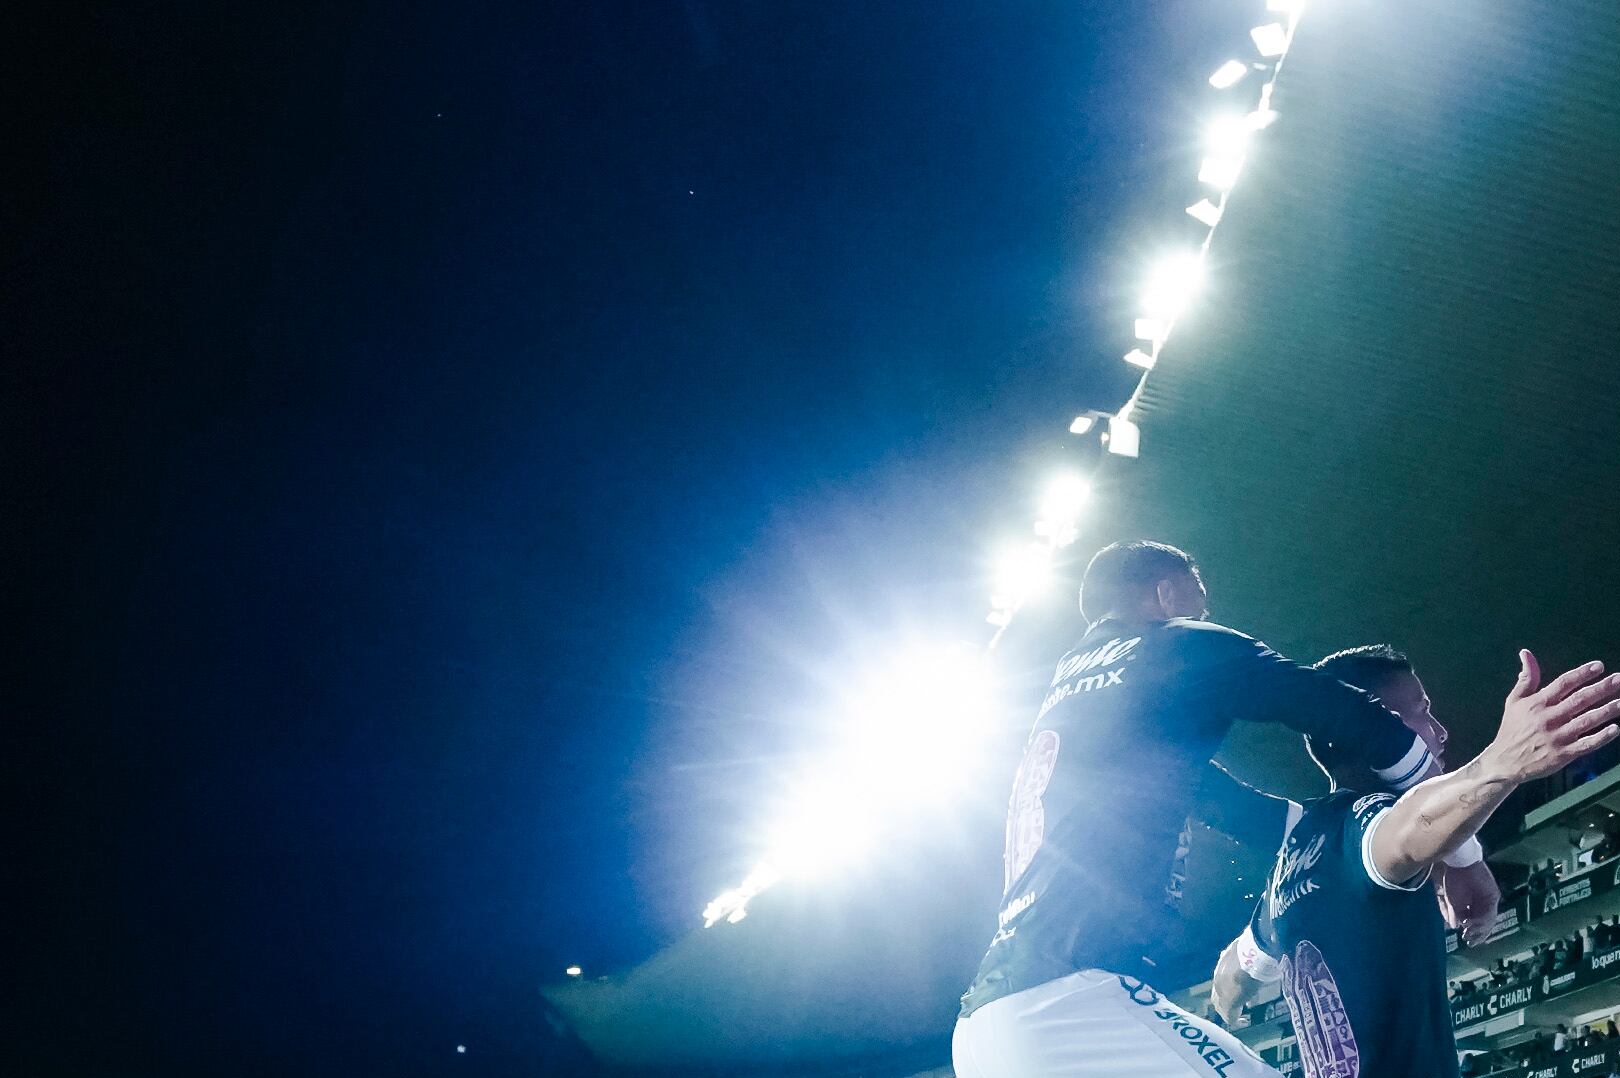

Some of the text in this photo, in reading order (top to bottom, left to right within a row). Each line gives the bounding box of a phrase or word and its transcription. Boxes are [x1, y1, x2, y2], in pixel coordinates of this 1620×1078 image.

[1499, 985, 1532, 1009] CHARLY
[1455, 1003, 1485, 1025] CHARLY
[1581, 1053, 1606, 1069] CHARLY
